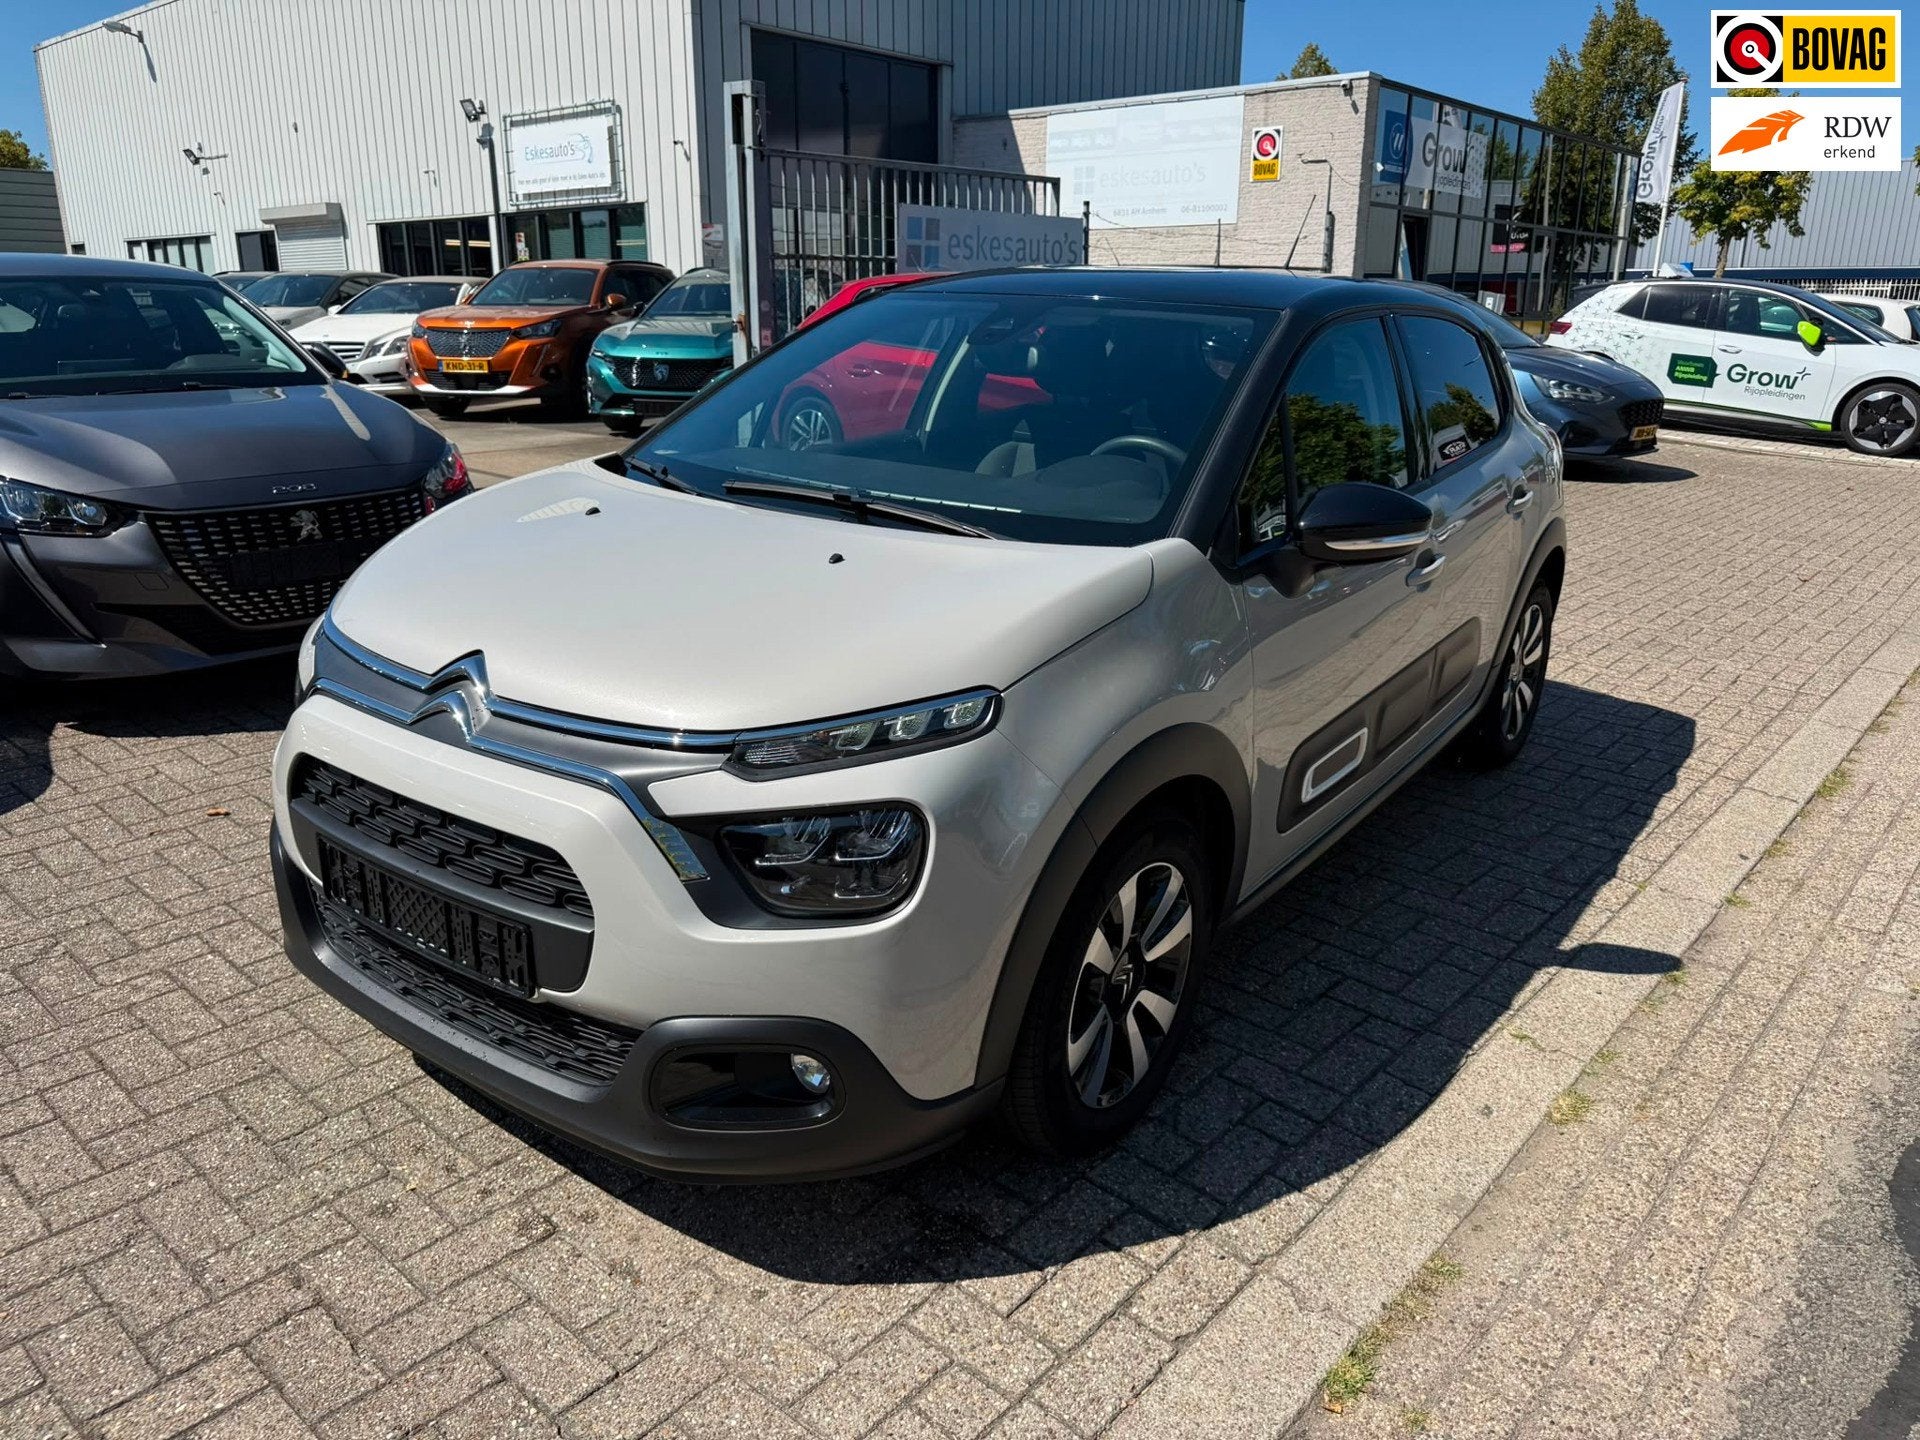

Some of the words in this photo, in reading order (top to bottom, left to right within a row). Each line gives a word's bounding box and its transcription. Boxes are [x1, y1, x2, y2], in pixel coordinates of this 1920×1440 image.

[524, 141, 575, 161] Eskesauto's
[1422, 131, 1466, 174] Grow
[1100, 163, 1206, 188] eskesauto's
[1253, 162, 1276, 176] BOVAG
[947, 225, 1078, 265] eskesauto's
[1727, 363, 1799, 390] Grow
[1744, 385, 1806, 401] Rijopleidingen
